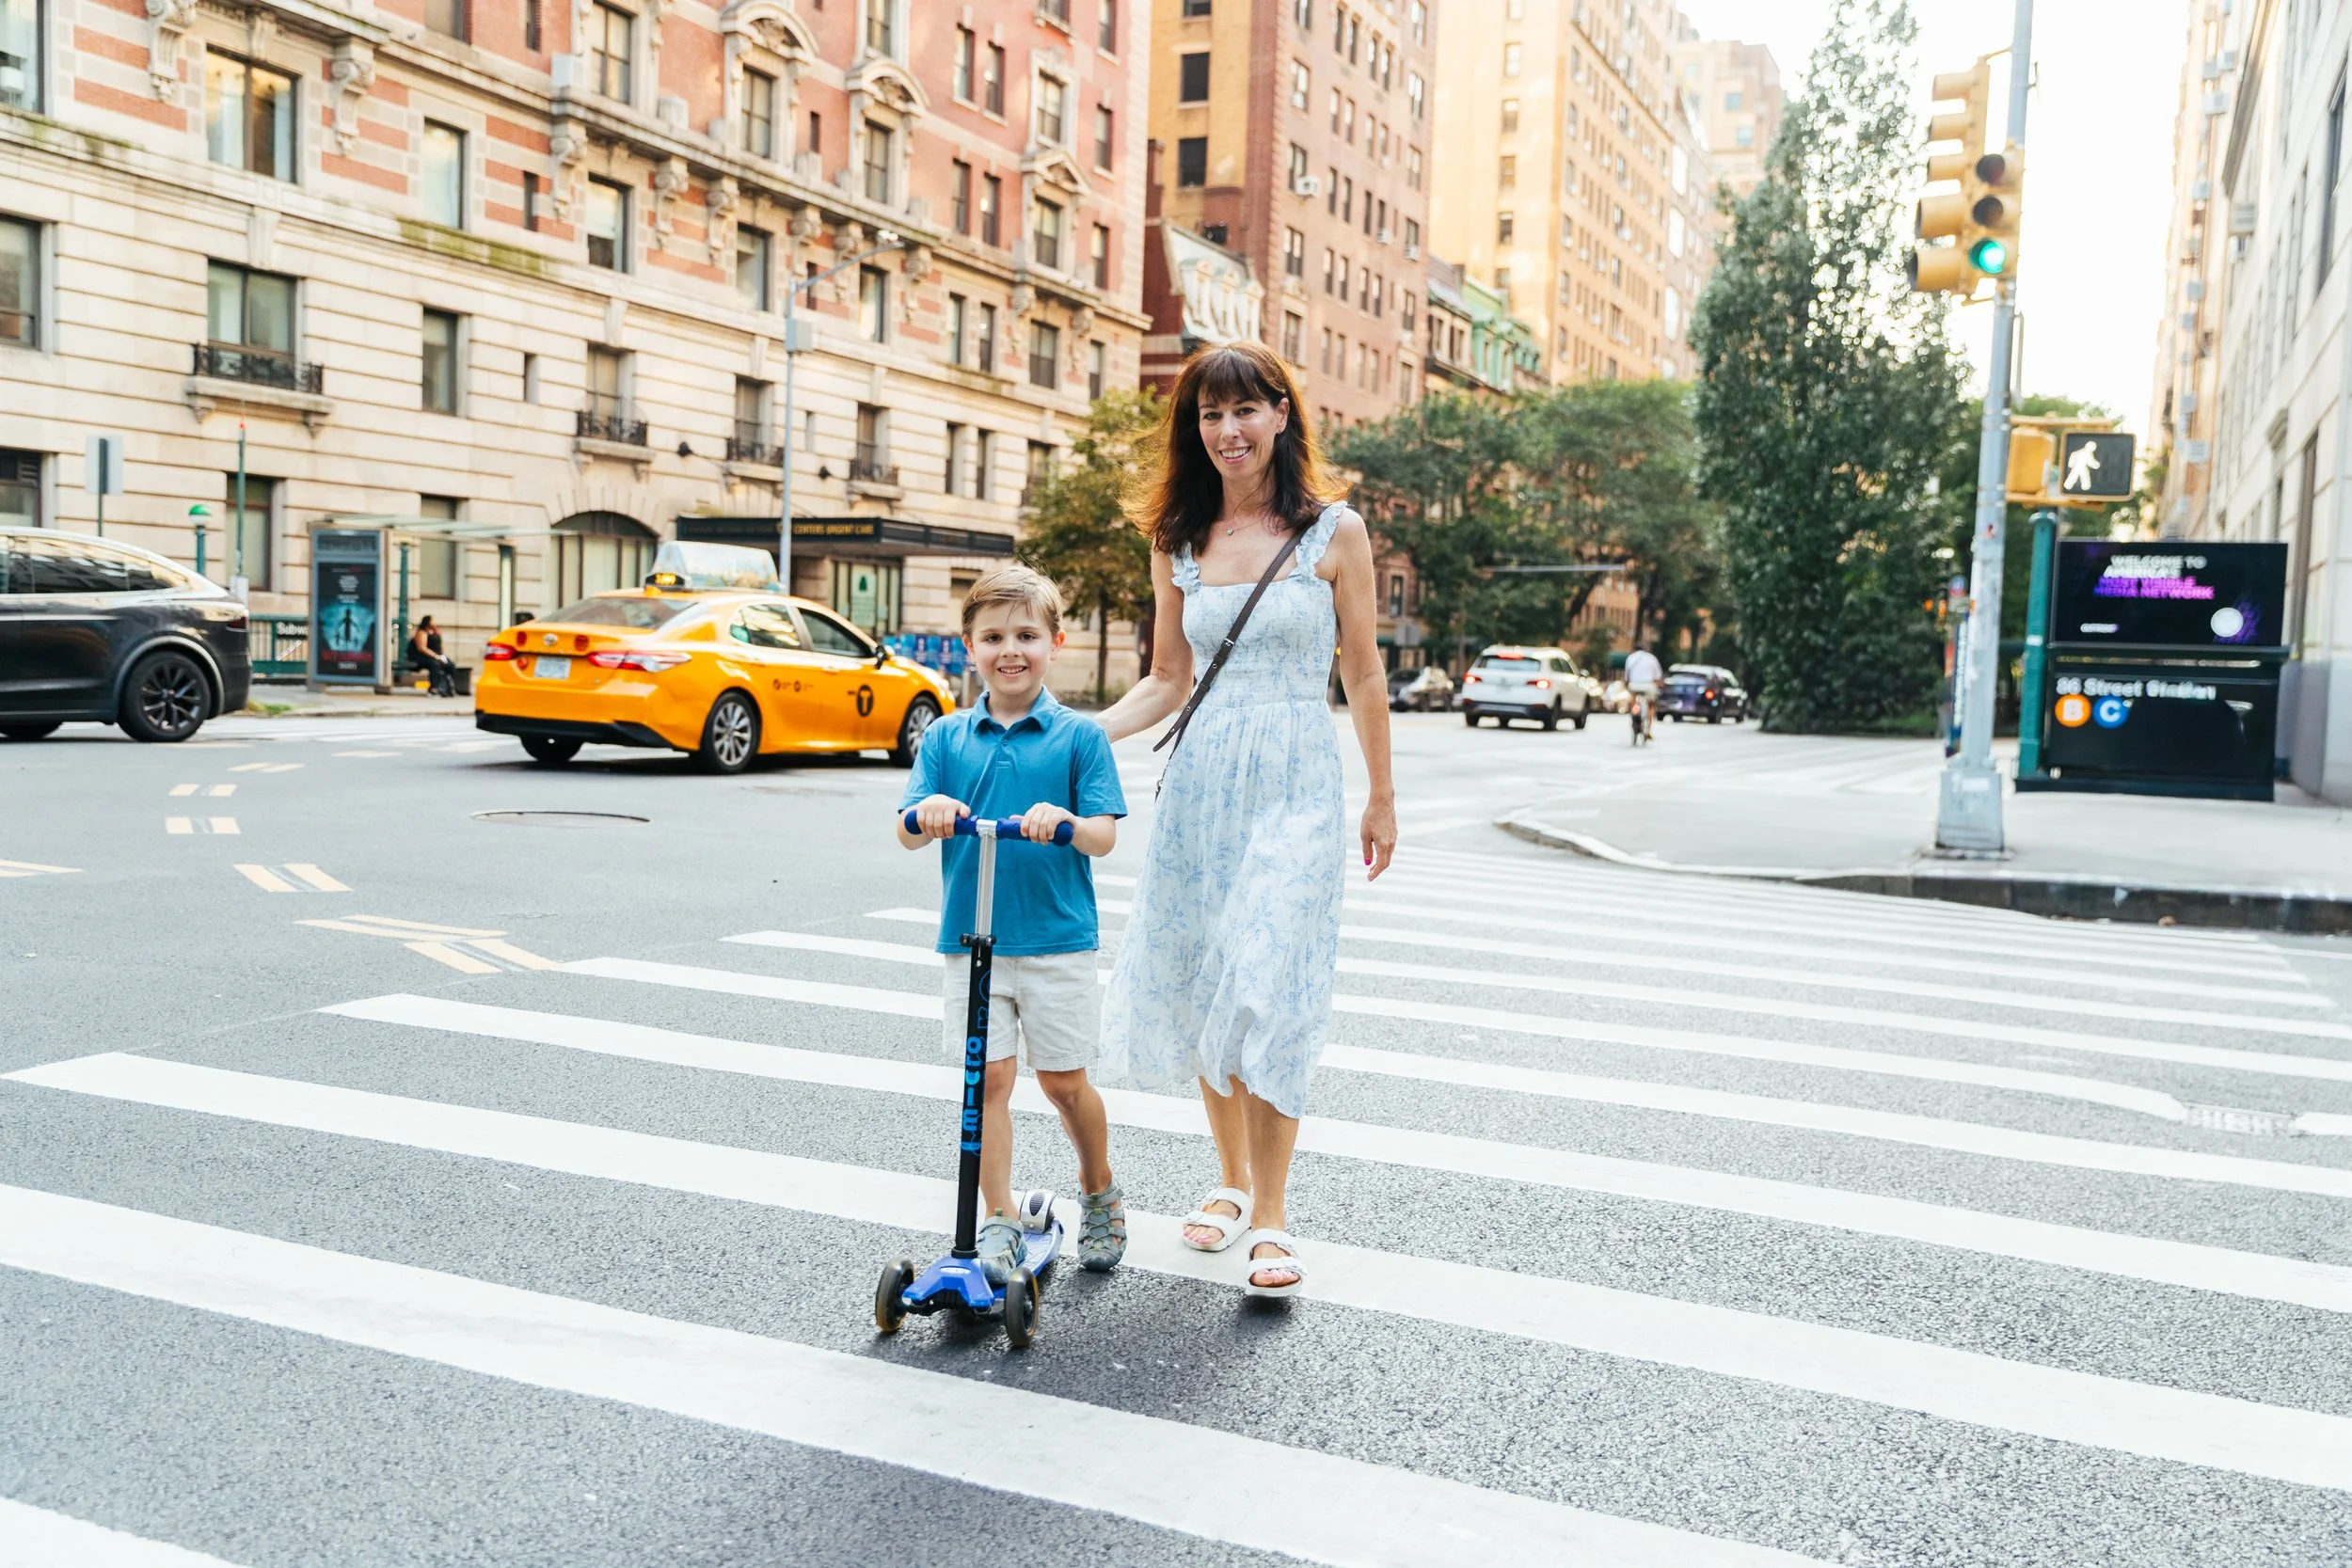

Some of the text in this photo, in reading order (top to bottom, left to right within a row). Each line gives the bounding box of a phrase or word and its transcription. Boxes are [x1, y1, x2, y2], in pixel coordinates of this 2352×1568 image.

[826, 523, 853, 535] URGENT
[854, 523, 875, 535] CARE
[2110, 555, 2207, 569] WELCOME TO
[2093, 586, 2214, 599] MEDIA NETWORK
[277, 622, 309, 636] Subwa
[2056, 676, 2082, 695] 86
[2083, 677, 2144, 697] Street
[2063, 699, 2122, 722] B C
[963, 1036, 982, 1132] micro
